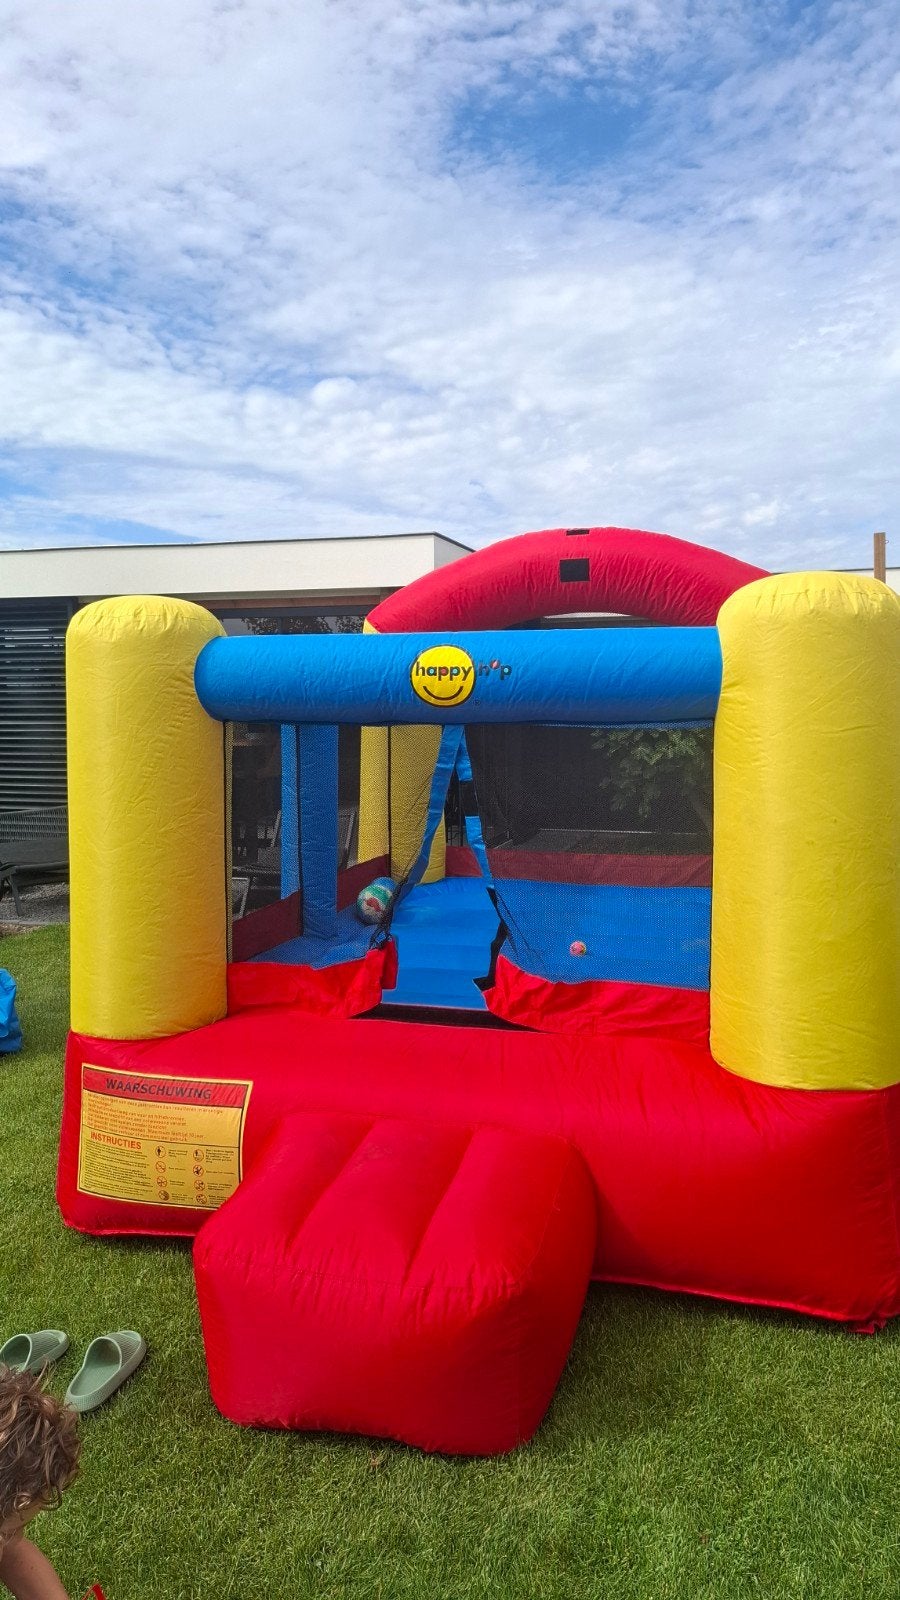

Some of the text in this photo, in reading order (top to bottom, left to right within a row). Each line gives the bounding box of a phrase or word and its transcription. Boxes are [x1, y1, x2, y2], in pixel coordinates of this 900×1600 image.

[415, 661, 473, 681] happy
[105, 1078, 213, 1099] WAARSCHUWING
[90, 1132, 142, 1150] INSTRUCTIES
